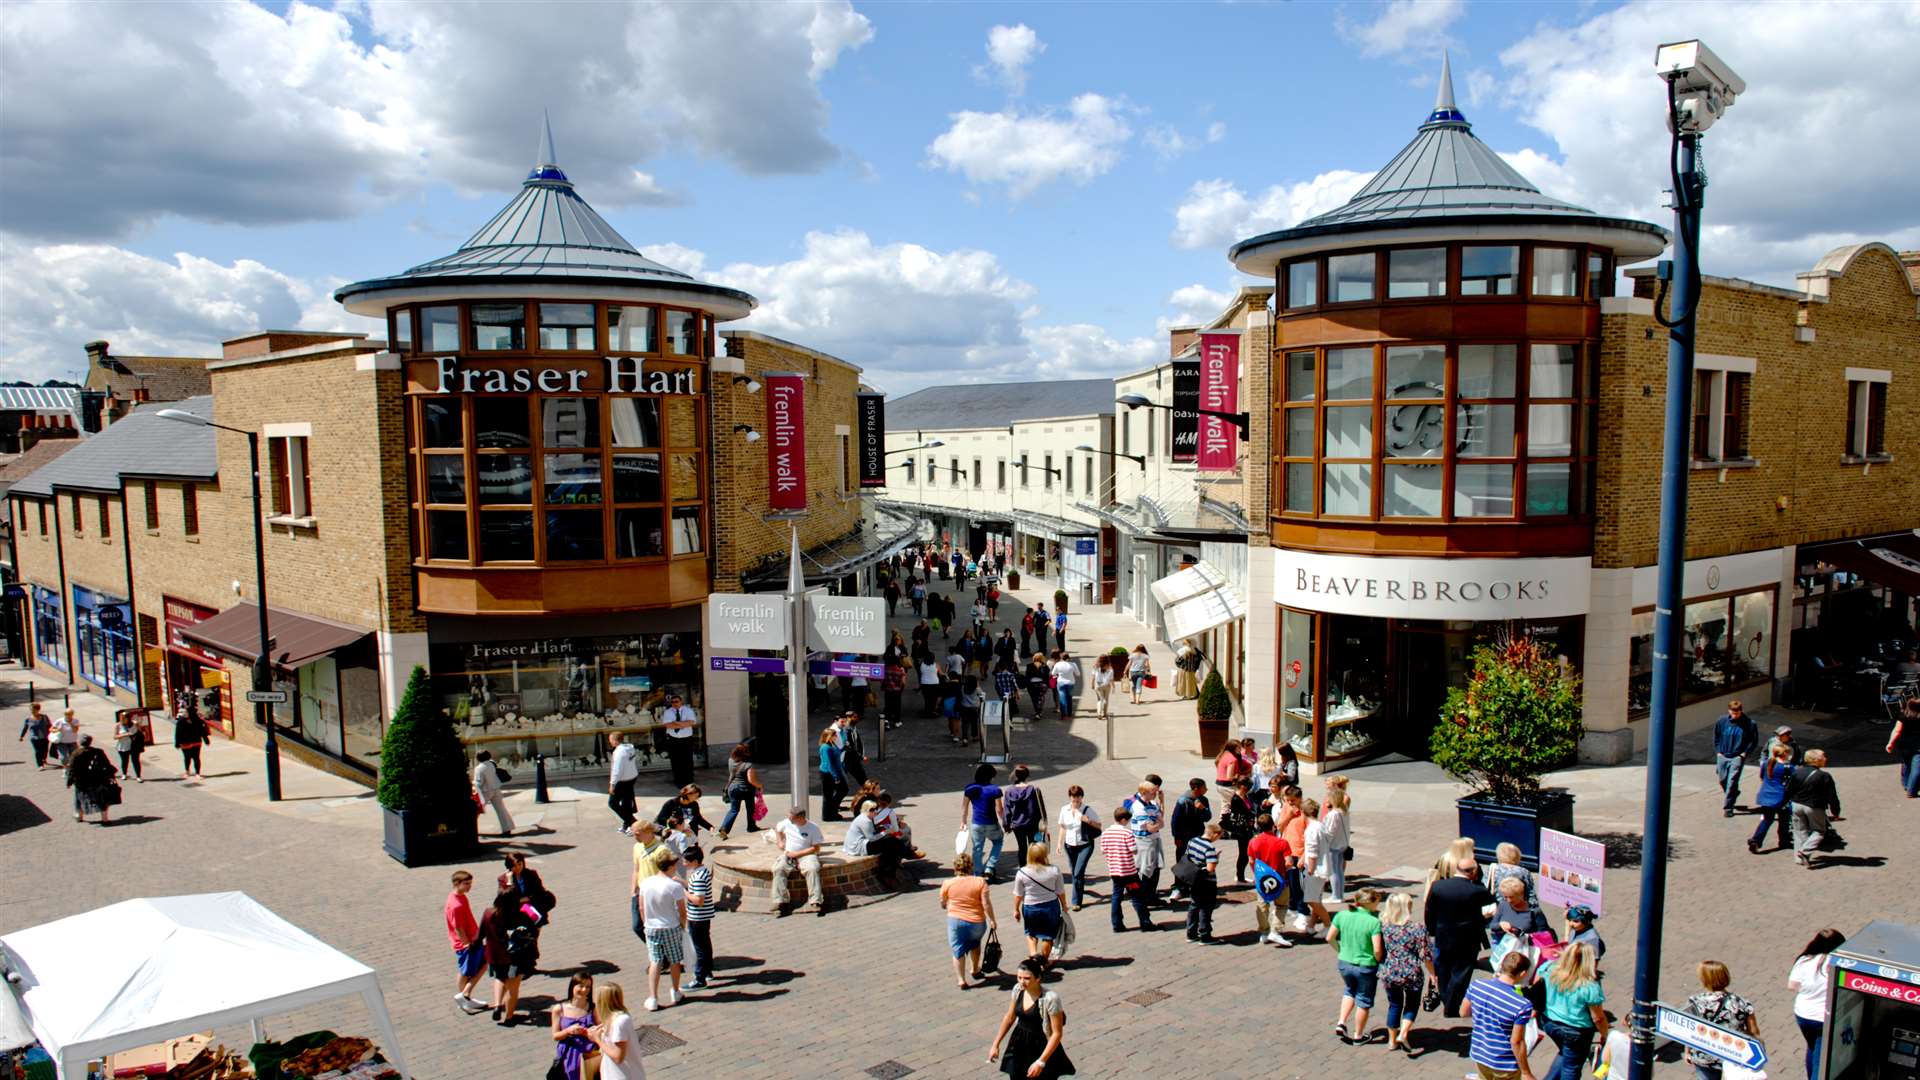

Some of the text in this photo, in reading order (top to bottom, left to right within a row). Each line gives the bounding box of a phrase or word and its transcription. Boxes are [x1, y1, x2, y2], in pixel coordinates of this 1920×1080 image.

[433, 356, 697, 396] Fraser Hart
[1174, 369, 1200, 377] ZARA
[1206, 344, 1230, 455] fremlin walk
[866, 399, 876, 430] FRASER
[774, 386, 797, 492] fremlin walk
[867, 432, 876, 445] OF
[1175, 431, 1199, 446] H&M
[867, 446, 877, 476] HOUSE
[1296, 567, 1548, 602] BEAVERBROOKS
[719, 602, 774, 618] fremlin
[818, 604, 874, 621] fremlin
[729, 618, 765, 633] walk
[828, 621, 865, 637] walk
[473, 641, 573, 657] Fraser Hart
[1851, 977, 1889, 995] Coins
[1890, 987, 1903, 999] &
[1663, 1010, 1696, 1031] TOILETS
